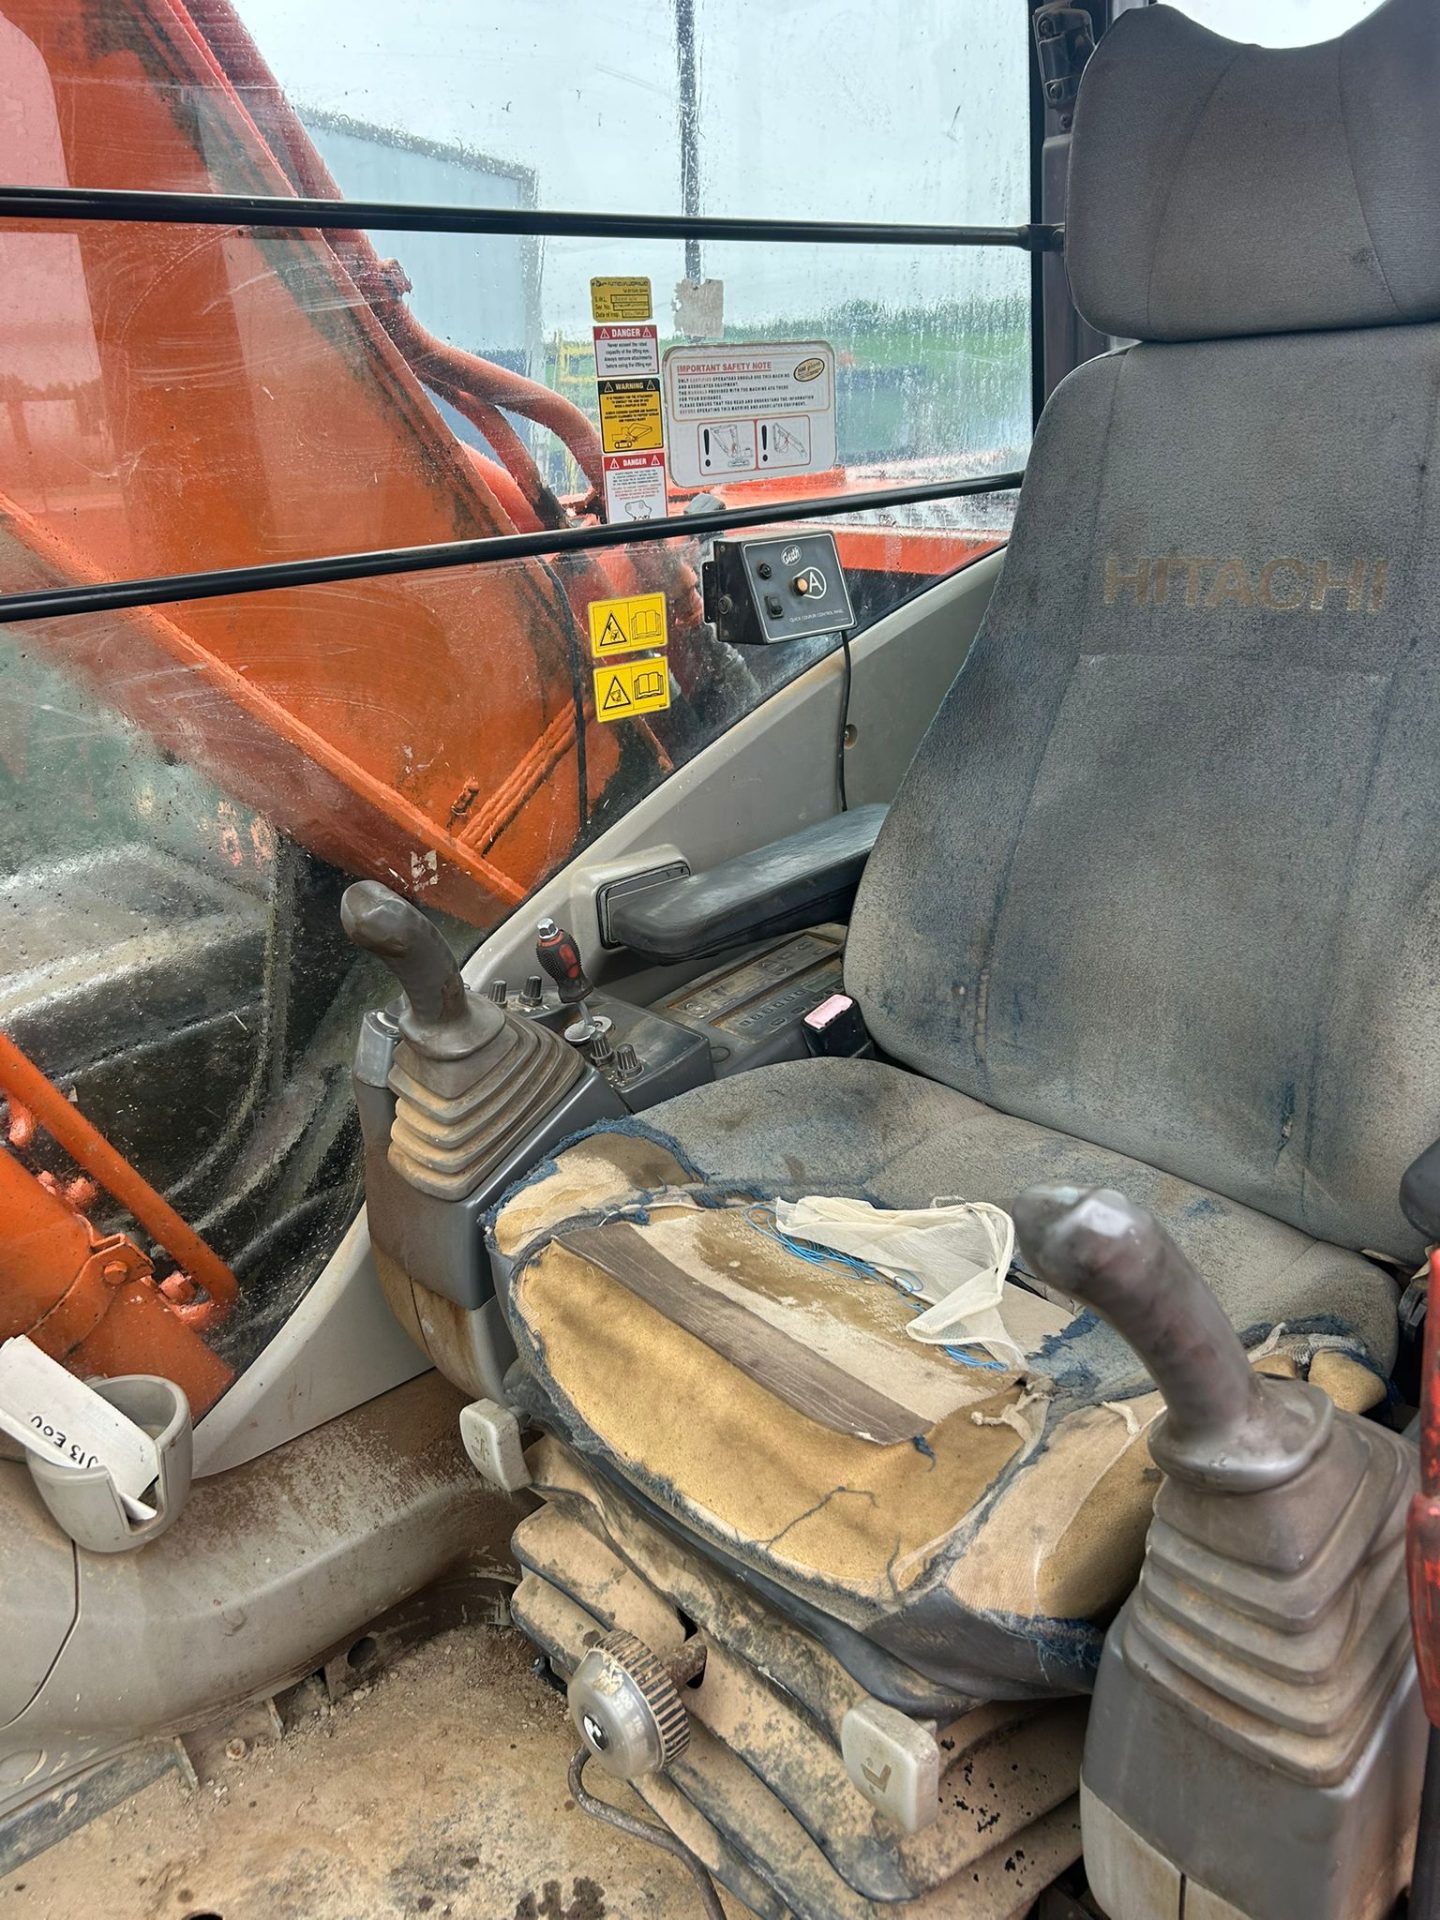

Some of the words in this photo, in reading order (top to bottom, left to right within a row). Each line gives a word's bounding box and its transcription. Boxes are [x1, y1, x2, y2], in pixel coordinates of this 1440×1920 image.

[612, 329, 641, 337] DANGER
[677, 363, 720, 373] IMPORTANT
[723, 362, 751, 371] SAFETY
[752, 362, 772, 370] NOTE
[615, 382, 643, 390] WARNING
[623, 458, 647, 467] DANGER
[808, 572, 823, 592] A
[1104, 557, 1390, 613] HITACHI
[70, 1444, 99, 1469] J13
